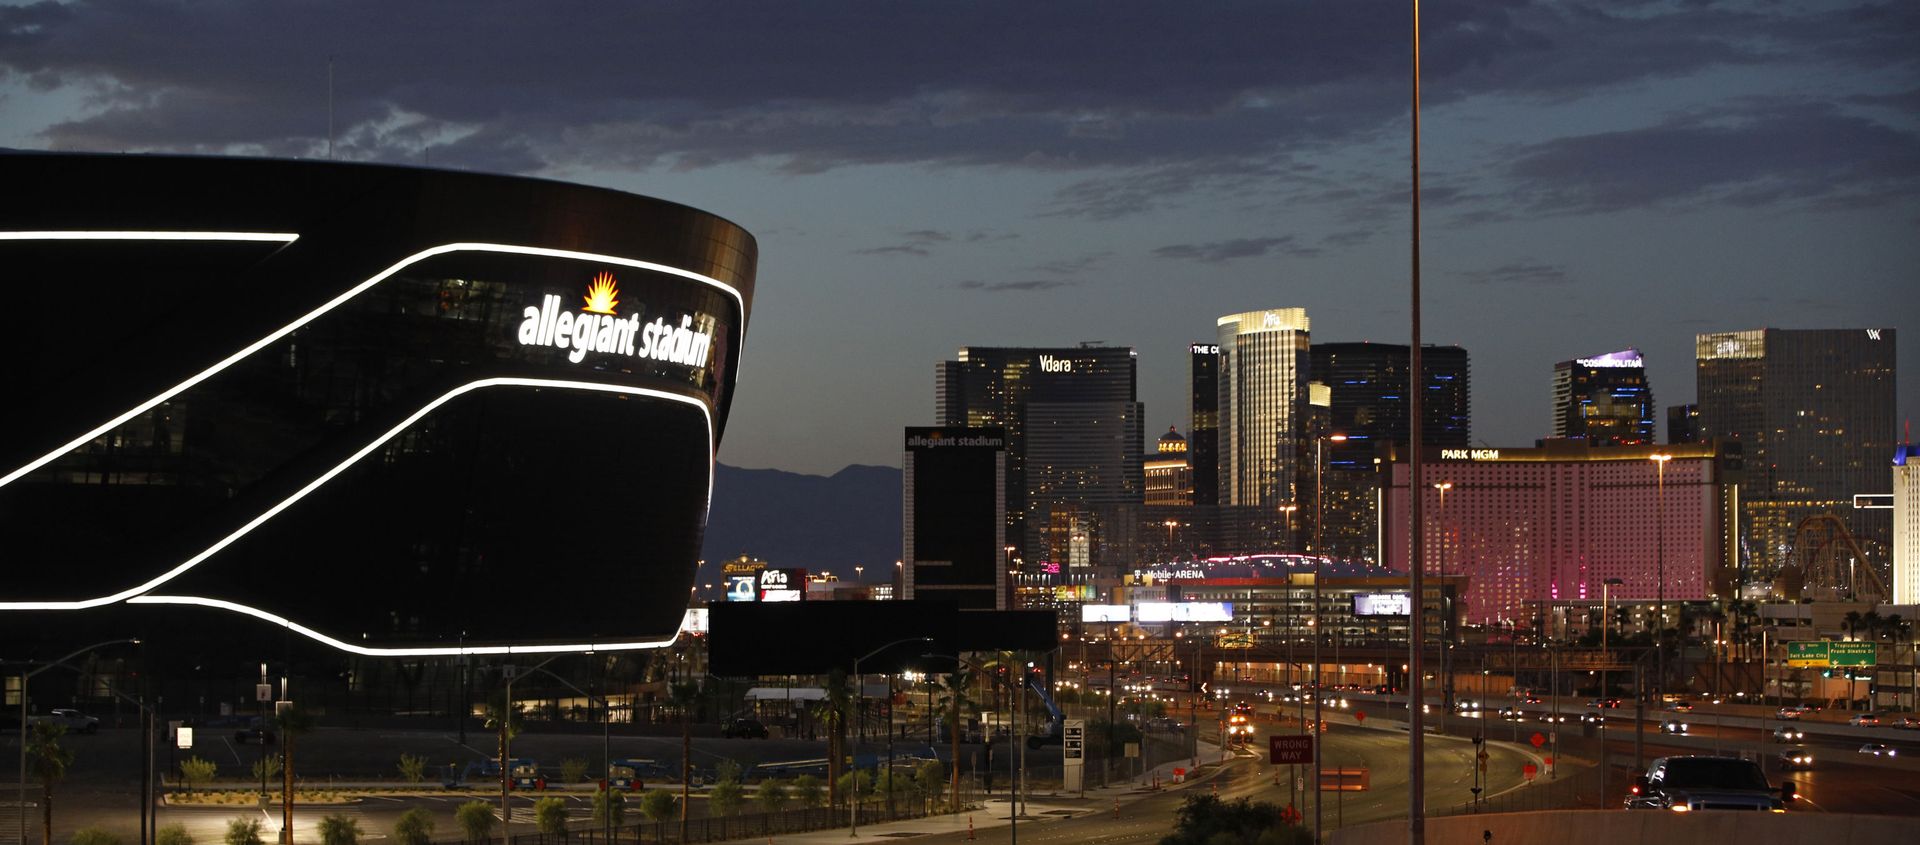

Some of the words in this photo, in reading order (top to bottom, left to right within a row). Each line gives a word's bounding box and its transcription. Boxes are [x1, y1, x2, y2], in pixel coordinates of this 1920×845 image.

[518, 294, 639, 364] allegiant
[638, 314, 712, 368] stadium
[1193, 345, 1209, 354] THE
[1039, 354, 1071, 373] Vdara
[907, 435, 956, 448] allegiant
[958, 435, 1003, 447] stadium
[1441, 449, 1468, 460] PARK
[1471, 449, 1499, 460] MGM
[1175, 570, 1205, 579] ARENA
[1274, 739, 1309, 749] WRONG
[1281, 751, 1302, 761] WAY
